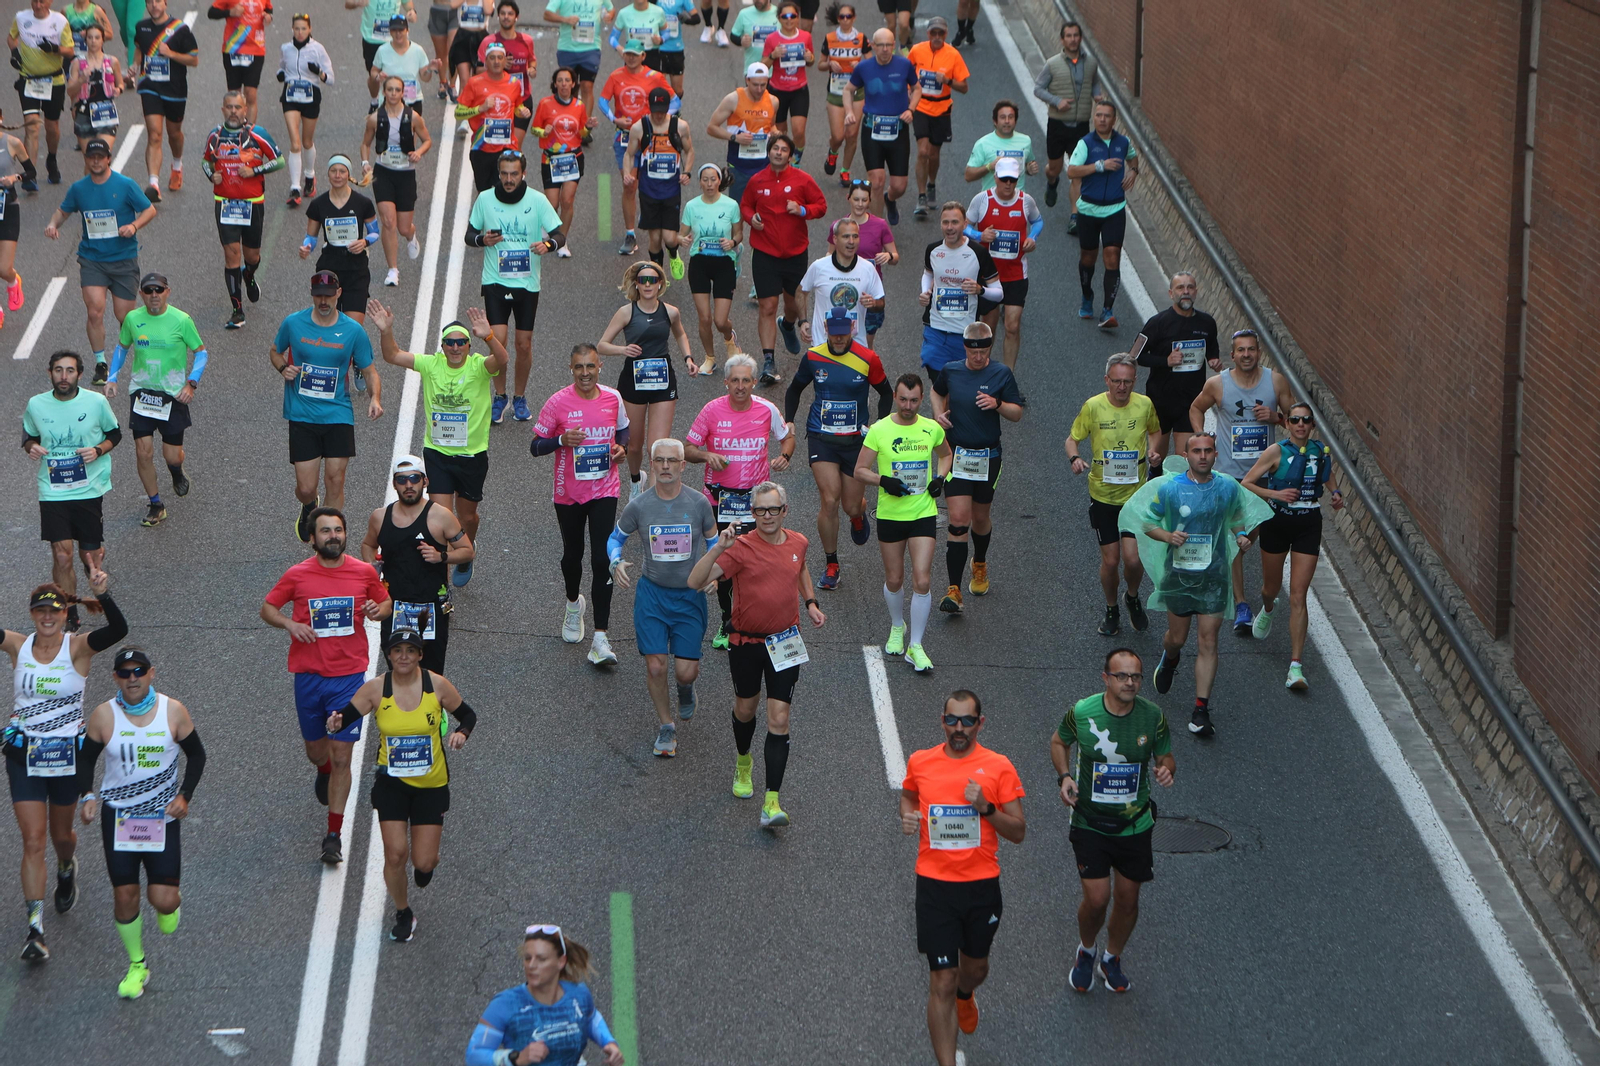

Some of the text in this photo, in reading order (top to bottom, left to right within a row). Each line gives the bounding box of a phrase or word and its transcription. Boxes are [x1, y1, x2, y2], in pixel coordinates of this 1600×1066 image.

[832, 48, 859, 56] ZPTG
[314, 368, 334, 376] ZURICH
[139, 391, 163, 407] 226ERS
[567, 410, 583, 418] ABB
[717, 420, 732, 428] ABB
[713, 437, 766, 450] E.KAMYR
[587, 446, 607, 454] ZURICH
[898, 444, 918, 452] WORLD
[59, 458, 80, 466] ZURICH
[36, 676, 62, 684] CARROS
[137, 745, 165, 753] CARROS
[137, 760, 160, 768] FUEGO
